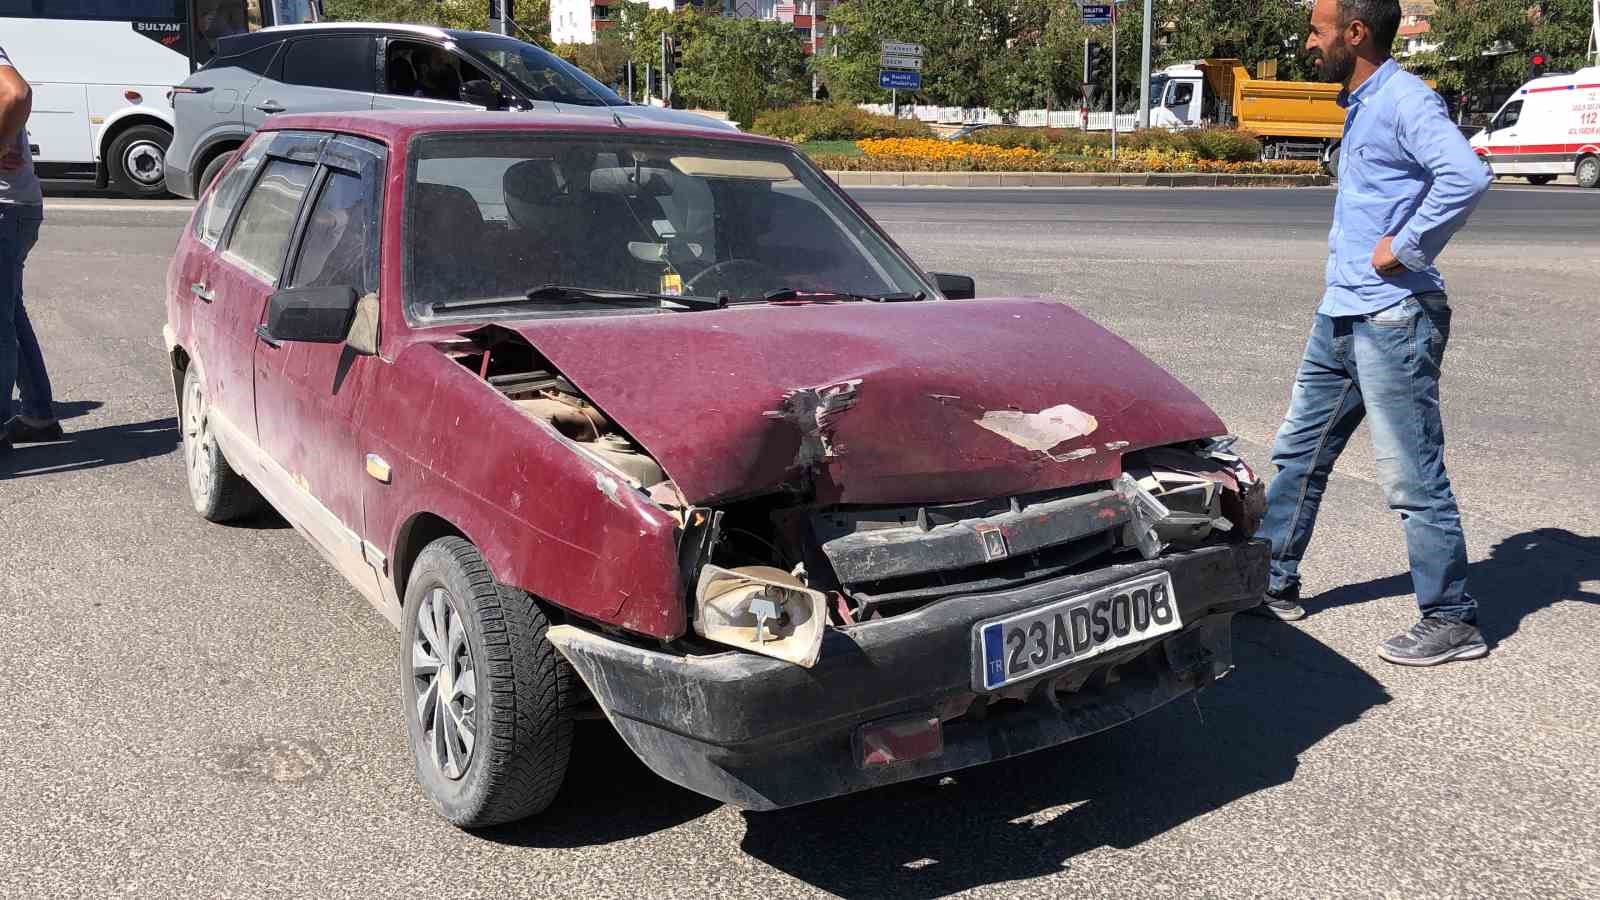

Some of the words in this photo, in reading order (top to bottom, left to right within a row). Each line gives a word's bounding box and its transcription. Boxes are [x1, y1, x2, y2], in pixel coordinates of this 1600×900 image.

[138, 22, 181, 32] SULTAN
[1580, 111, 1598, 125] 112
[1006, 583, 1173, 674] 23ADS008
[989, 659, 1004, 675] TR
